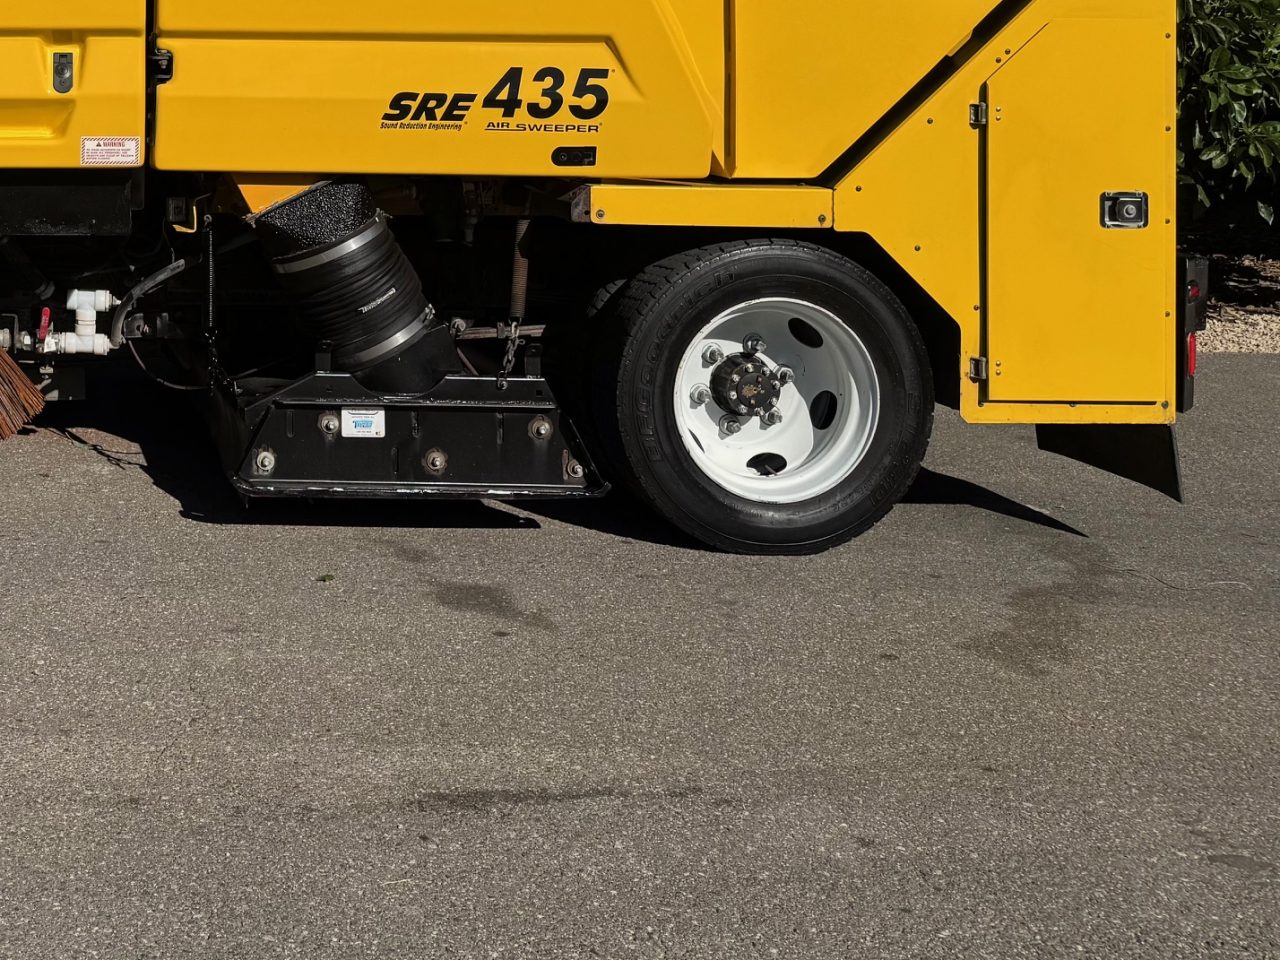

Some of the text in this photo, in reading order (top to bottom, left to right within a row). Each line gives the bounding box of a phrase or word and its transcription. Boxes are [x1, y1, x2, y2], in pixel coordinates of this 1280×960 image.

[381, 66, 610, 122] SRE 435
[379, 121, 463, 132] Sound Reduction Engineering
[486, 121, 600, 133] AIR SWEEPER
